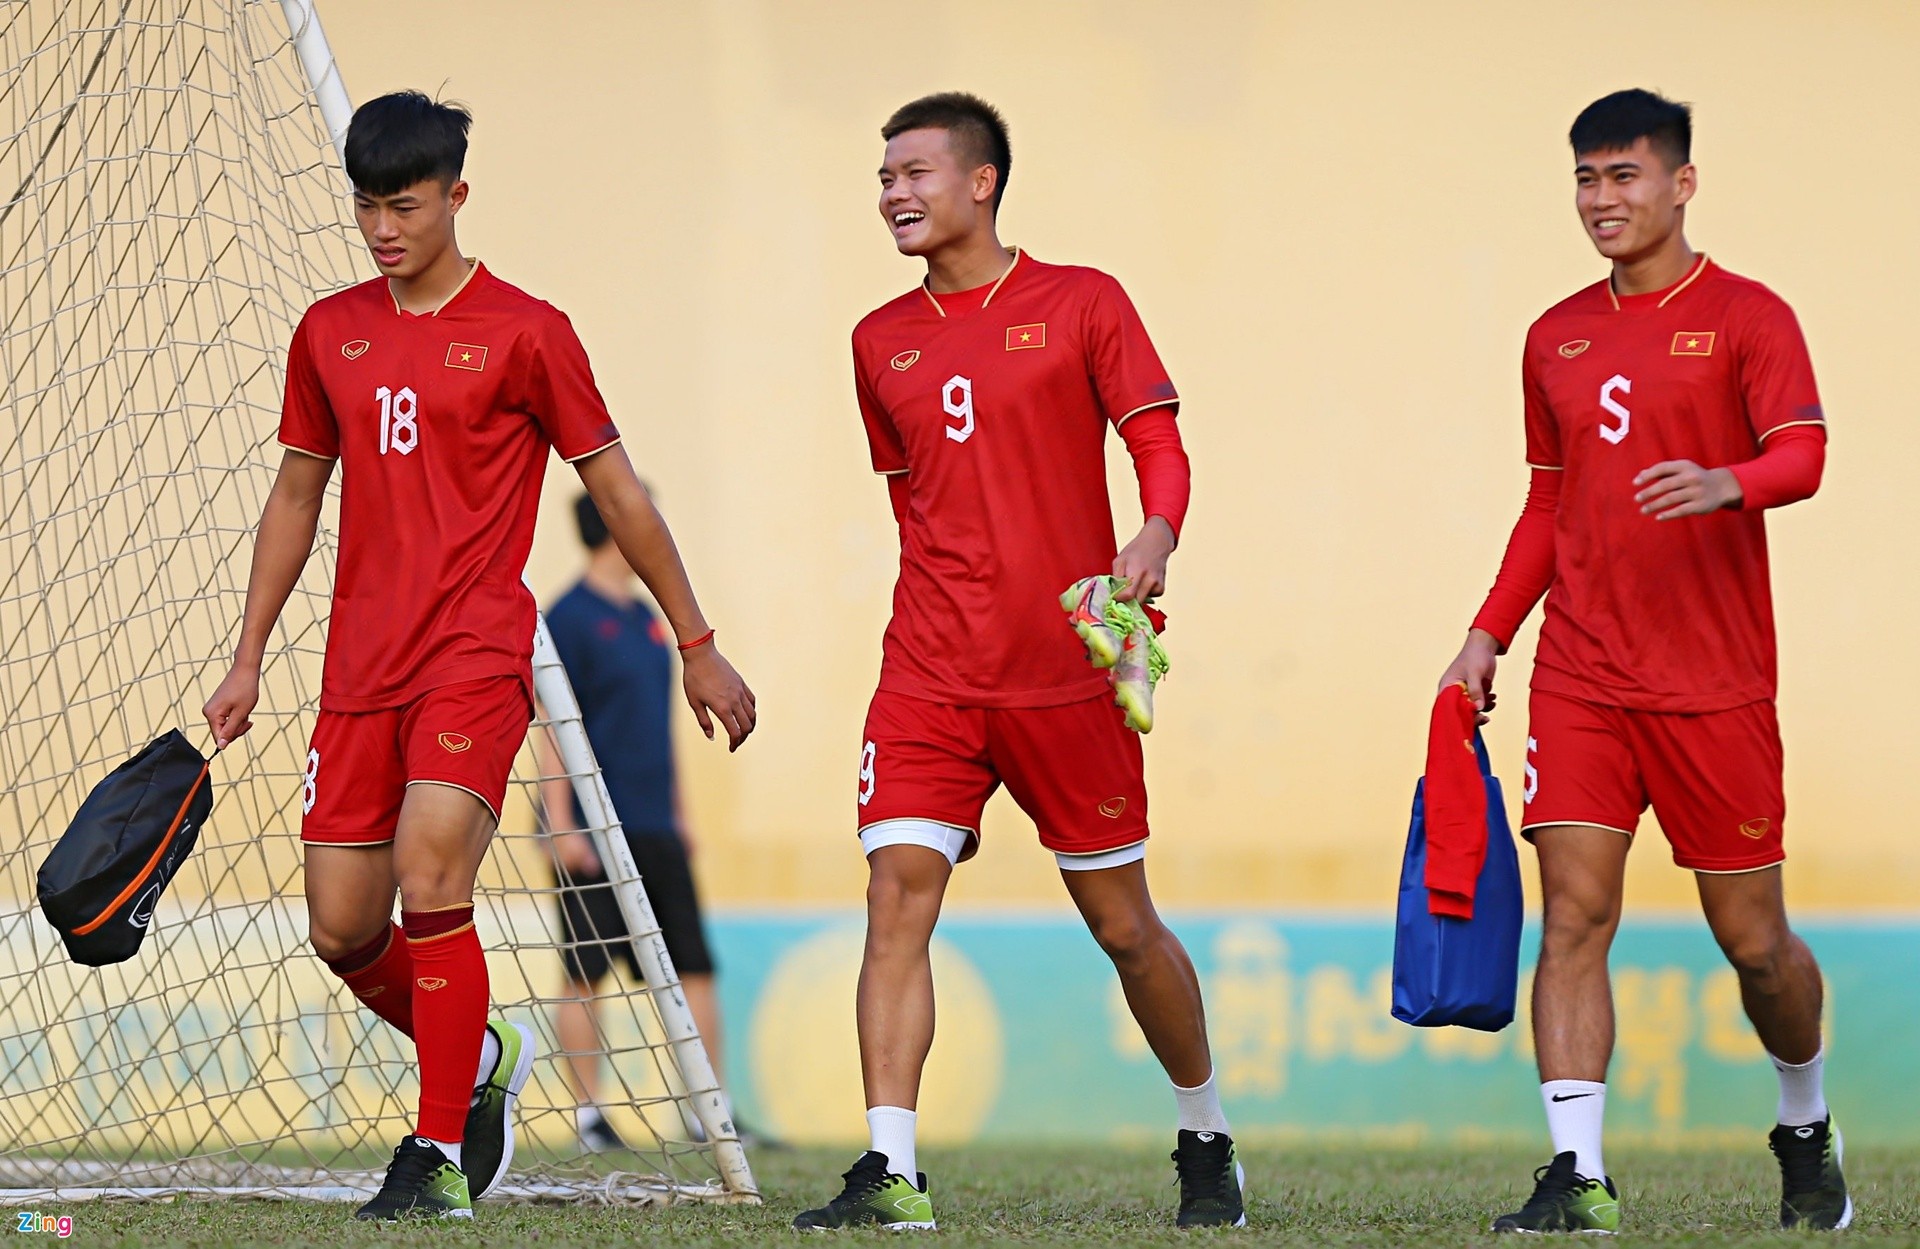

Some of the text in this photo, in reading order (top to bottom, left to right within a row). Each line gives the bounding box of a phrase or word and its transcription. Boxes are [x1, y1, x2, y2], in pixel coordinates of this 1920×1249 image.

[375, 385, 418, 456] 18
[941, 374, 975, 444] 9
[859, 740, 876, 807] 9
